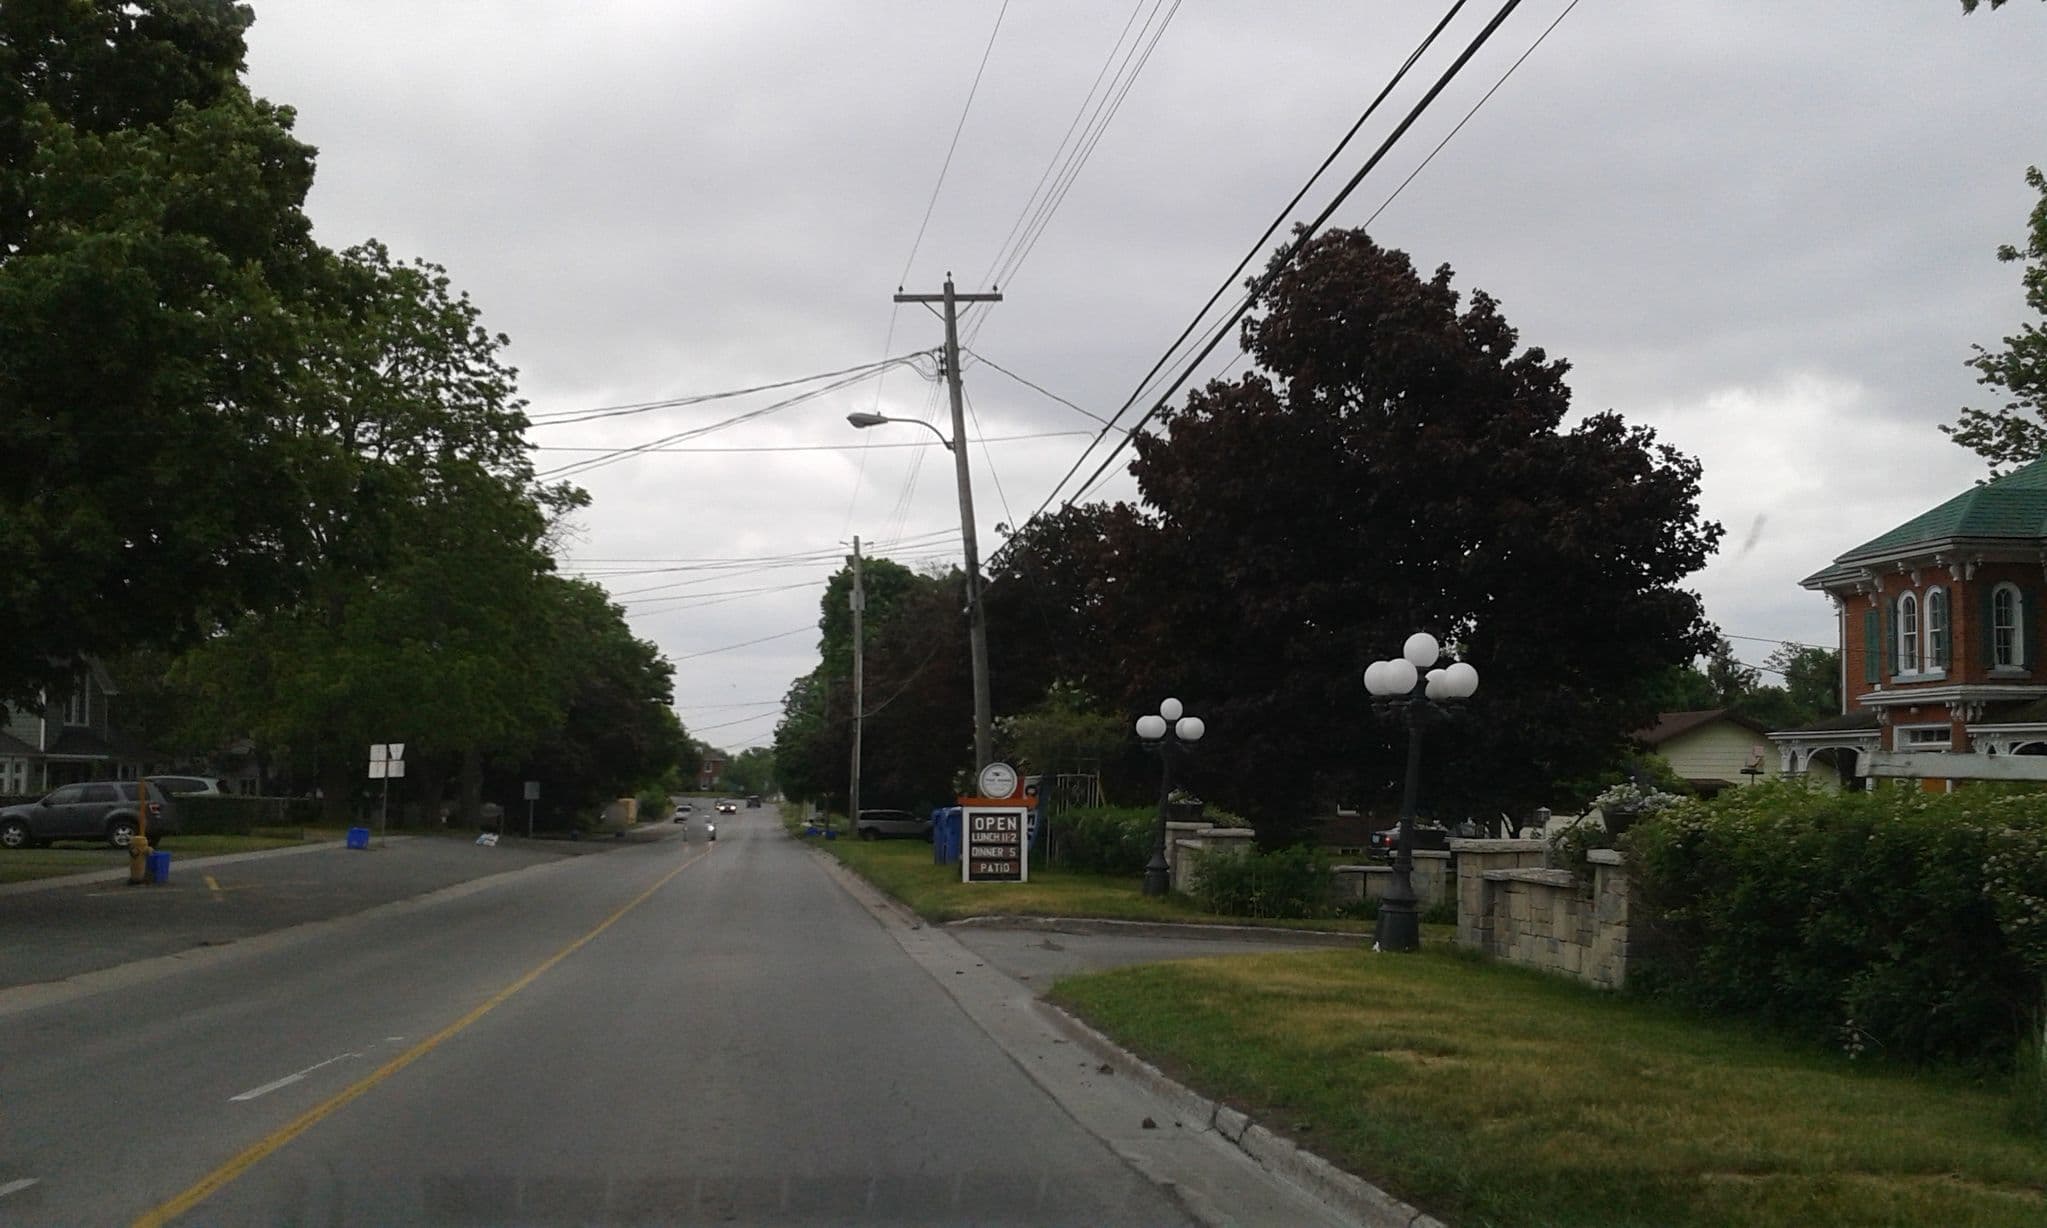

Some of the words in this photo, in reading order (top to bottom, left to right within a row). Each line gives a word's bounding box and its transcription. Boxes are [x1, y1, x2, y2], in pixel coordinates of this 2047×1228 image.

[975, 817, 1017, 830] OPEN
[971, 832, 1000, 842] LUNCH
[971, 847, 1004, 857] DINNER
[980, 863, 1010, 873] PATIO
